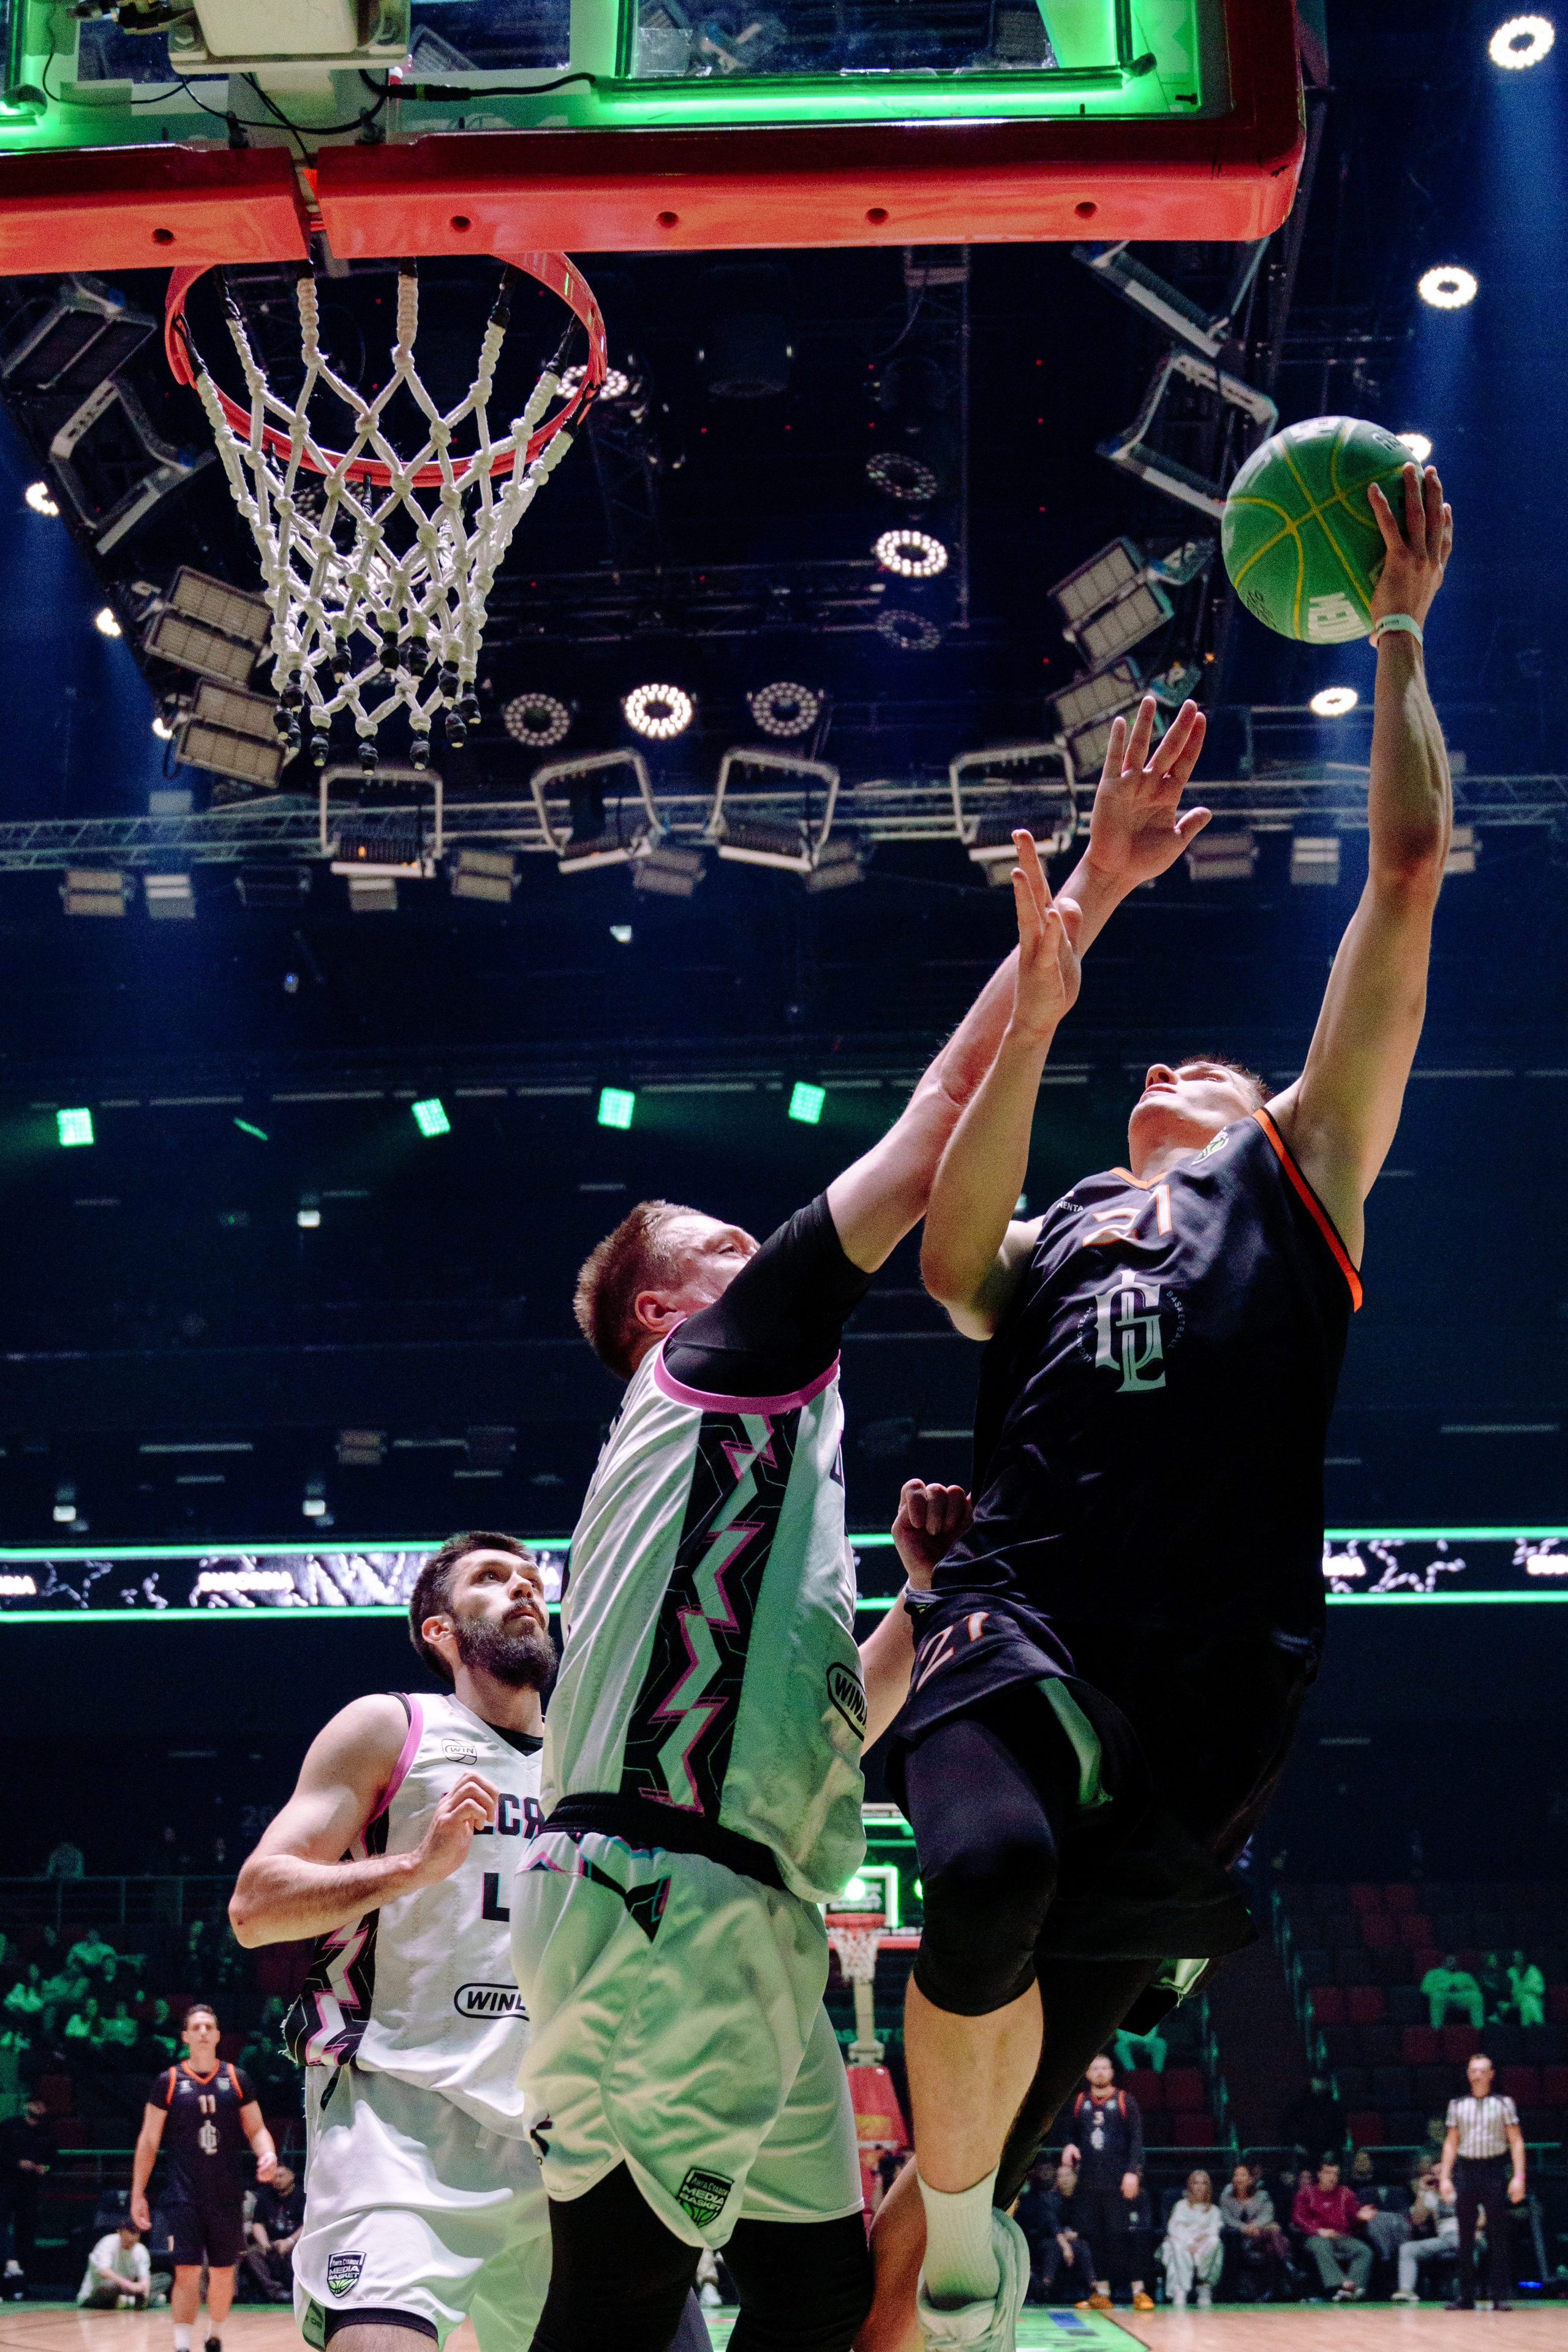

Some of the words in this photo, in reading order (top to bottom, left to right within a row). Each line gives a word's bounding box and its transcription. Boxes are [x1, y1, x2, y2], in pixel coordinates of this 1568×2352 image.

[1082, 1184, 1172, 1247] 21
[198, 2094, 216, 2115] 11
[679, 2192, 723, 2211] BASKET
[682, 2184, 725, 2205] MEDIA
[329, 2266, 360, 2275] MEDIA
